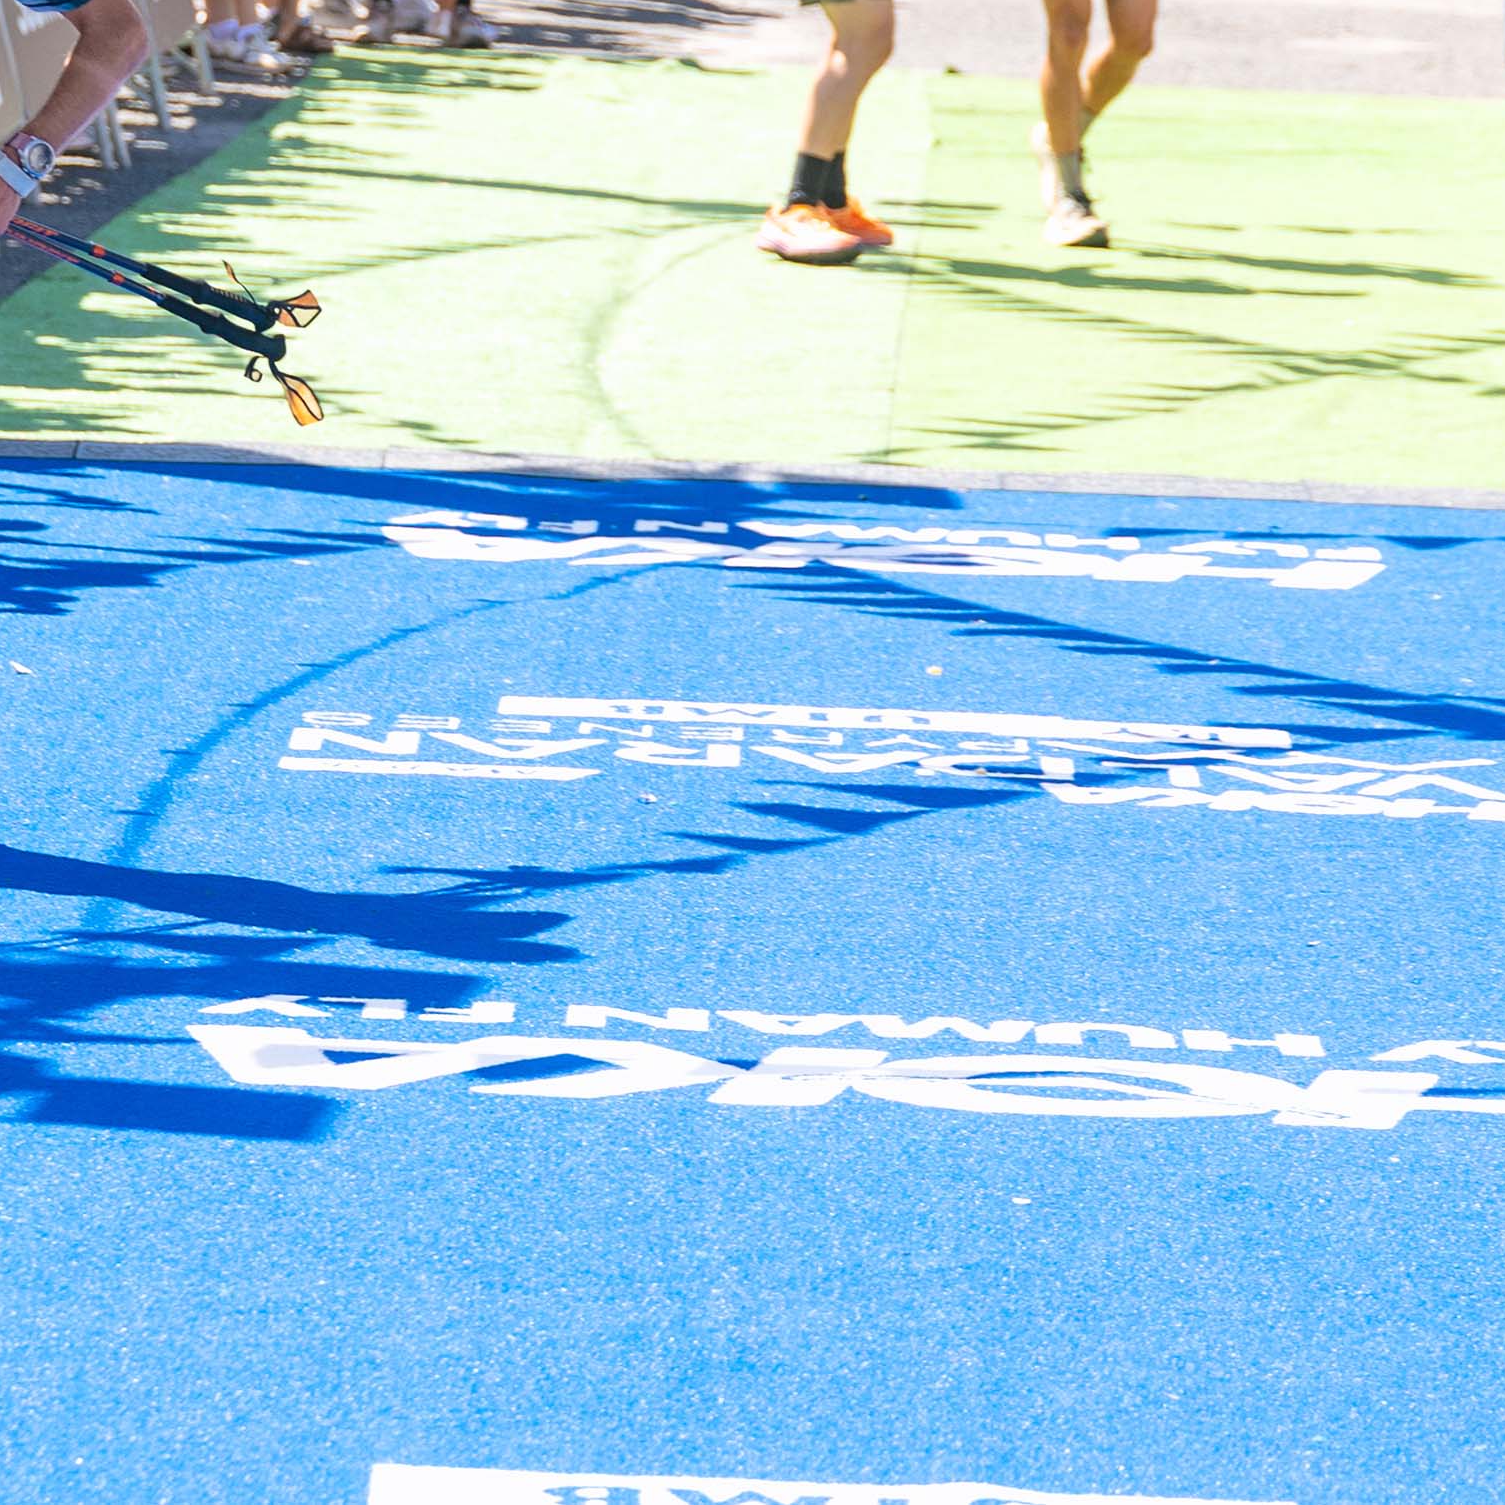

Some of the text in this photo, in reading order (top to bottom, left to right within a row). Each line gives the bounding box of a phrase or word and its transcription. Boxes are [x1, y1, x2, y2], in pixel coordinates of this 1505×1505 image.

[381, 525, 1387, 590] HOKA
[301, 709, 1029, 753] PYRENEES
[197, 994, 516, 1024] FLY
[564, 1002, 1327, 1058] HUMAN
